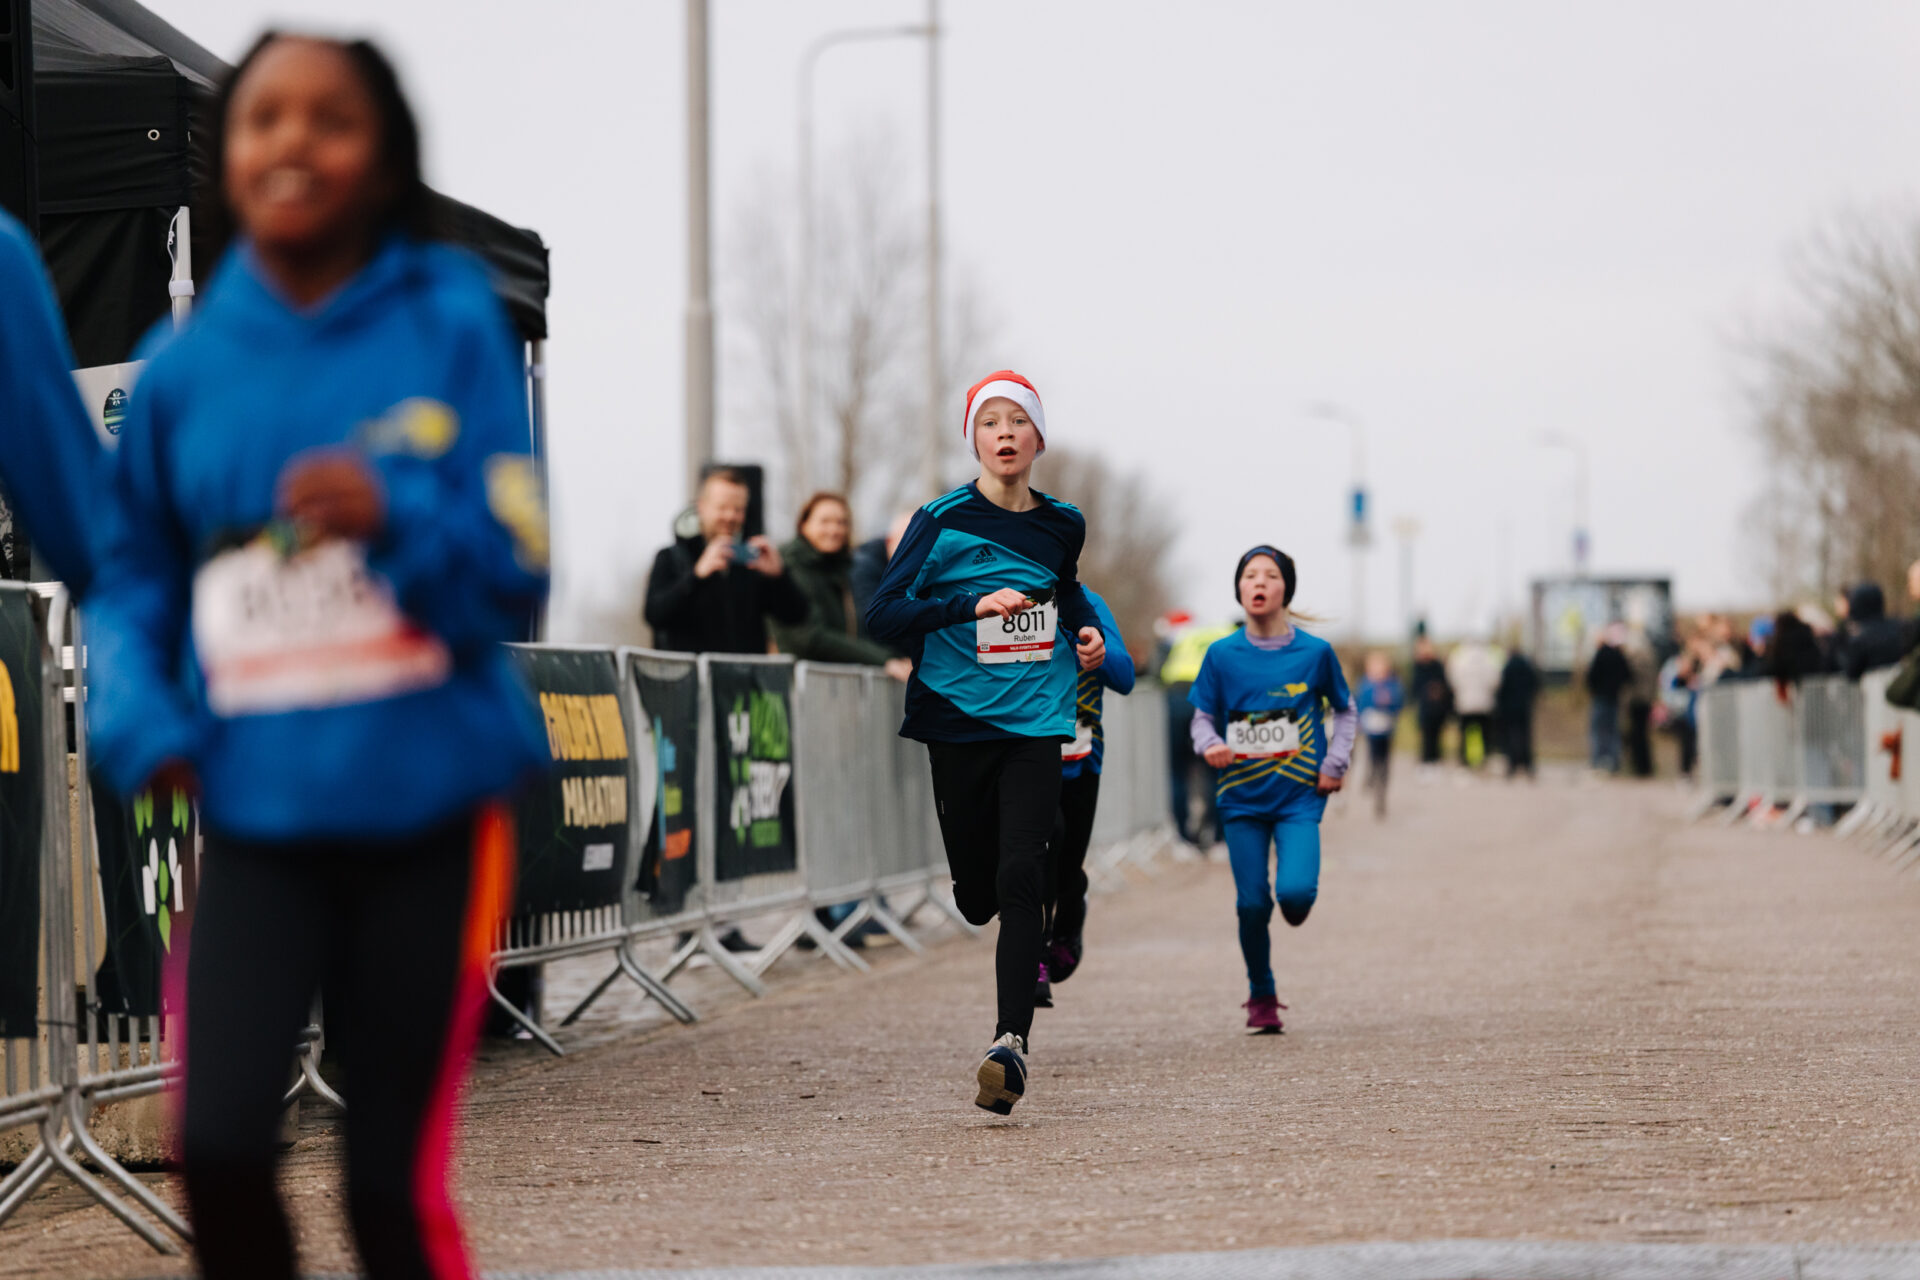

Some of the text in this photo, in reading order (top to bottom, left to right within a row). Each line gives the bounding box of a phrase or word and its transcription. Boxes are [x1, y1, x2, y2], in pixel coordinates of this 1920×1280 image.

[972, 556, 998, 565] adidas
[1001, 610, 1045, 634] 8011
[1013, 634, 1036, 642] Ruben
